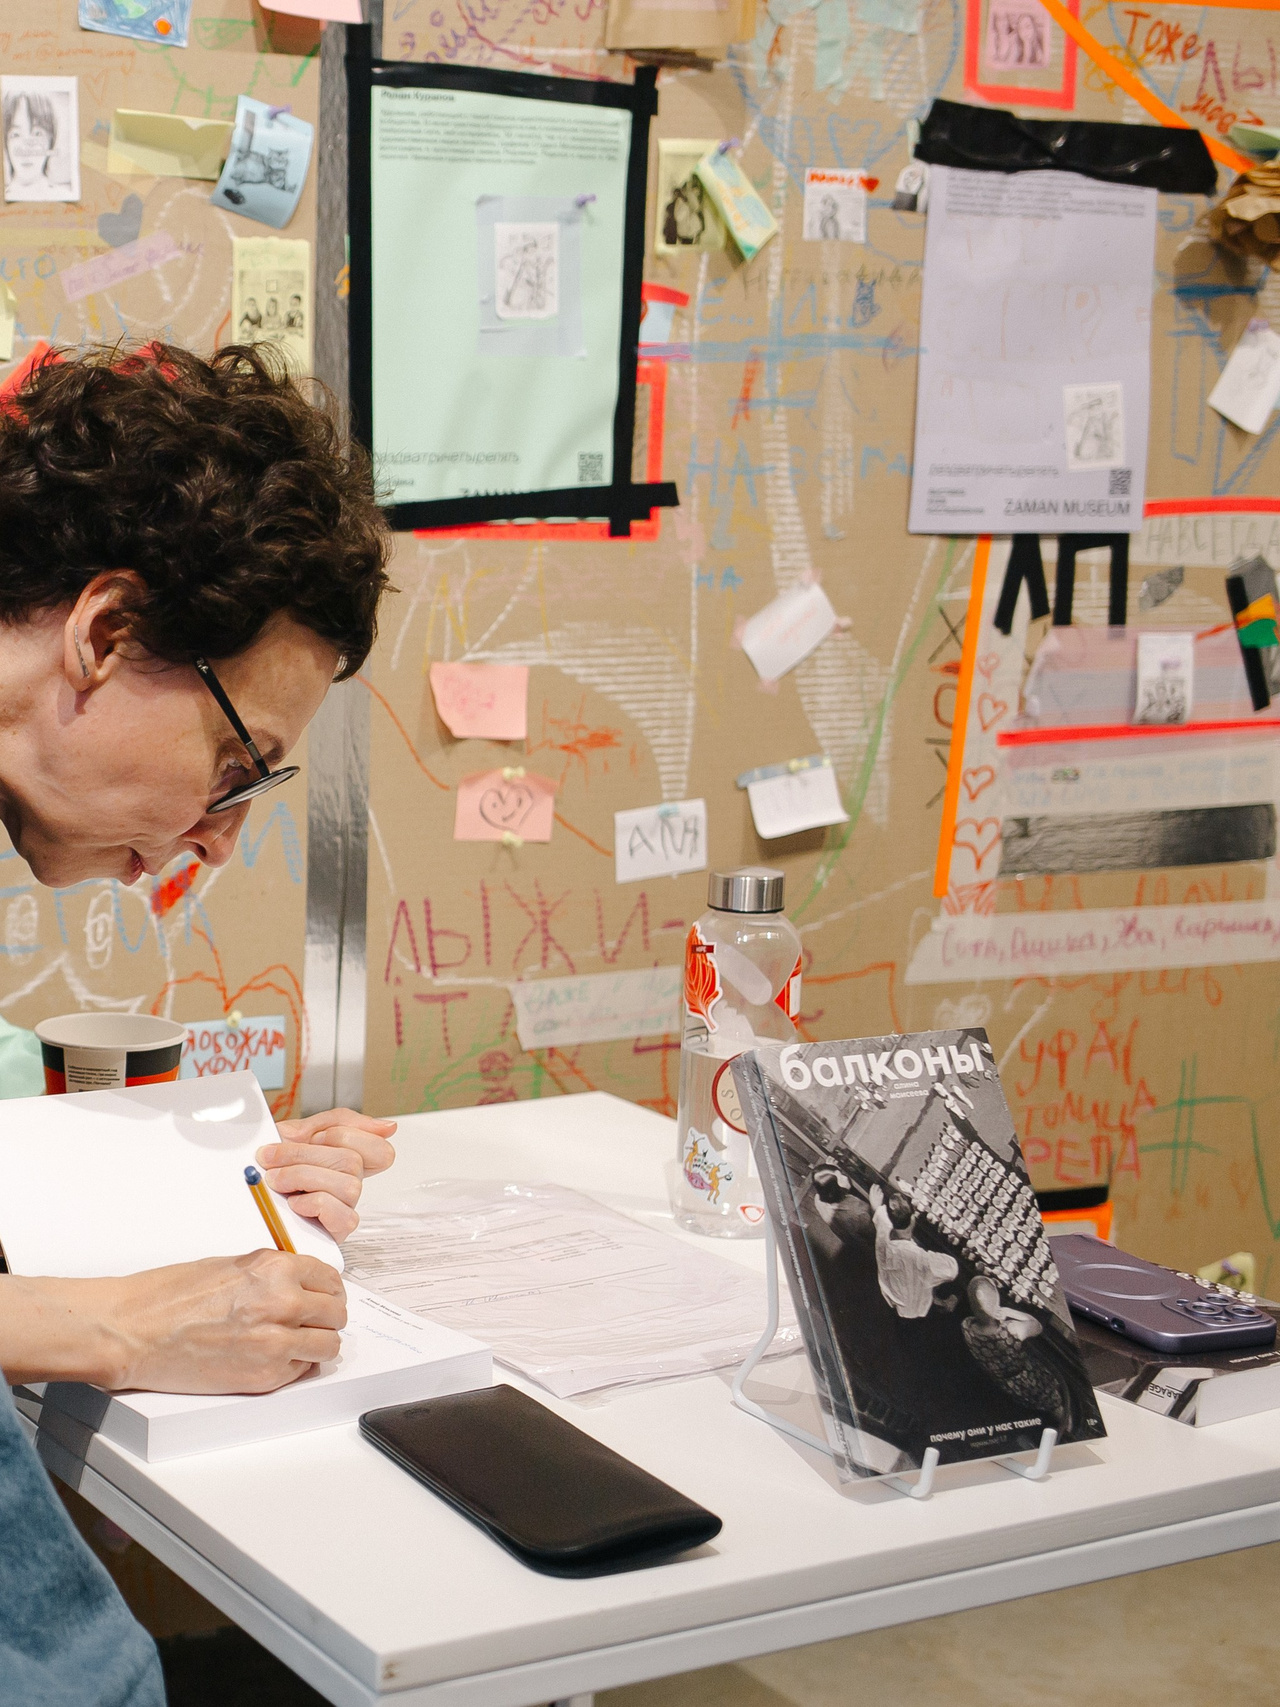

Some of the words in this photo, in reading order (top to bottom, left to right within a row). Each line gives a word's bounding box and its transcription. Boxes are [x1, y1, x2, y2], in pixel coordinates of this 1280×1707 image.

[1003, 498, 1059, 516] ZAMAN
[1062, 499, 1130, 517] MUSEUM
[780, 1043, 985, 1091] балконы
[889, 1089, 930, 1099] моисеева
[894, 1081, 920, 1089] алина
[1147, 1382, 1182, 1400] ARAGE
[930, 1429, 966, 1443] почему
[967, 1427, 987, 1437] они
[987, 1426, 995, 1436] у
[995, 1423, 1013, 1431] нас
[1013, 1417, 1042, 1429] такие
